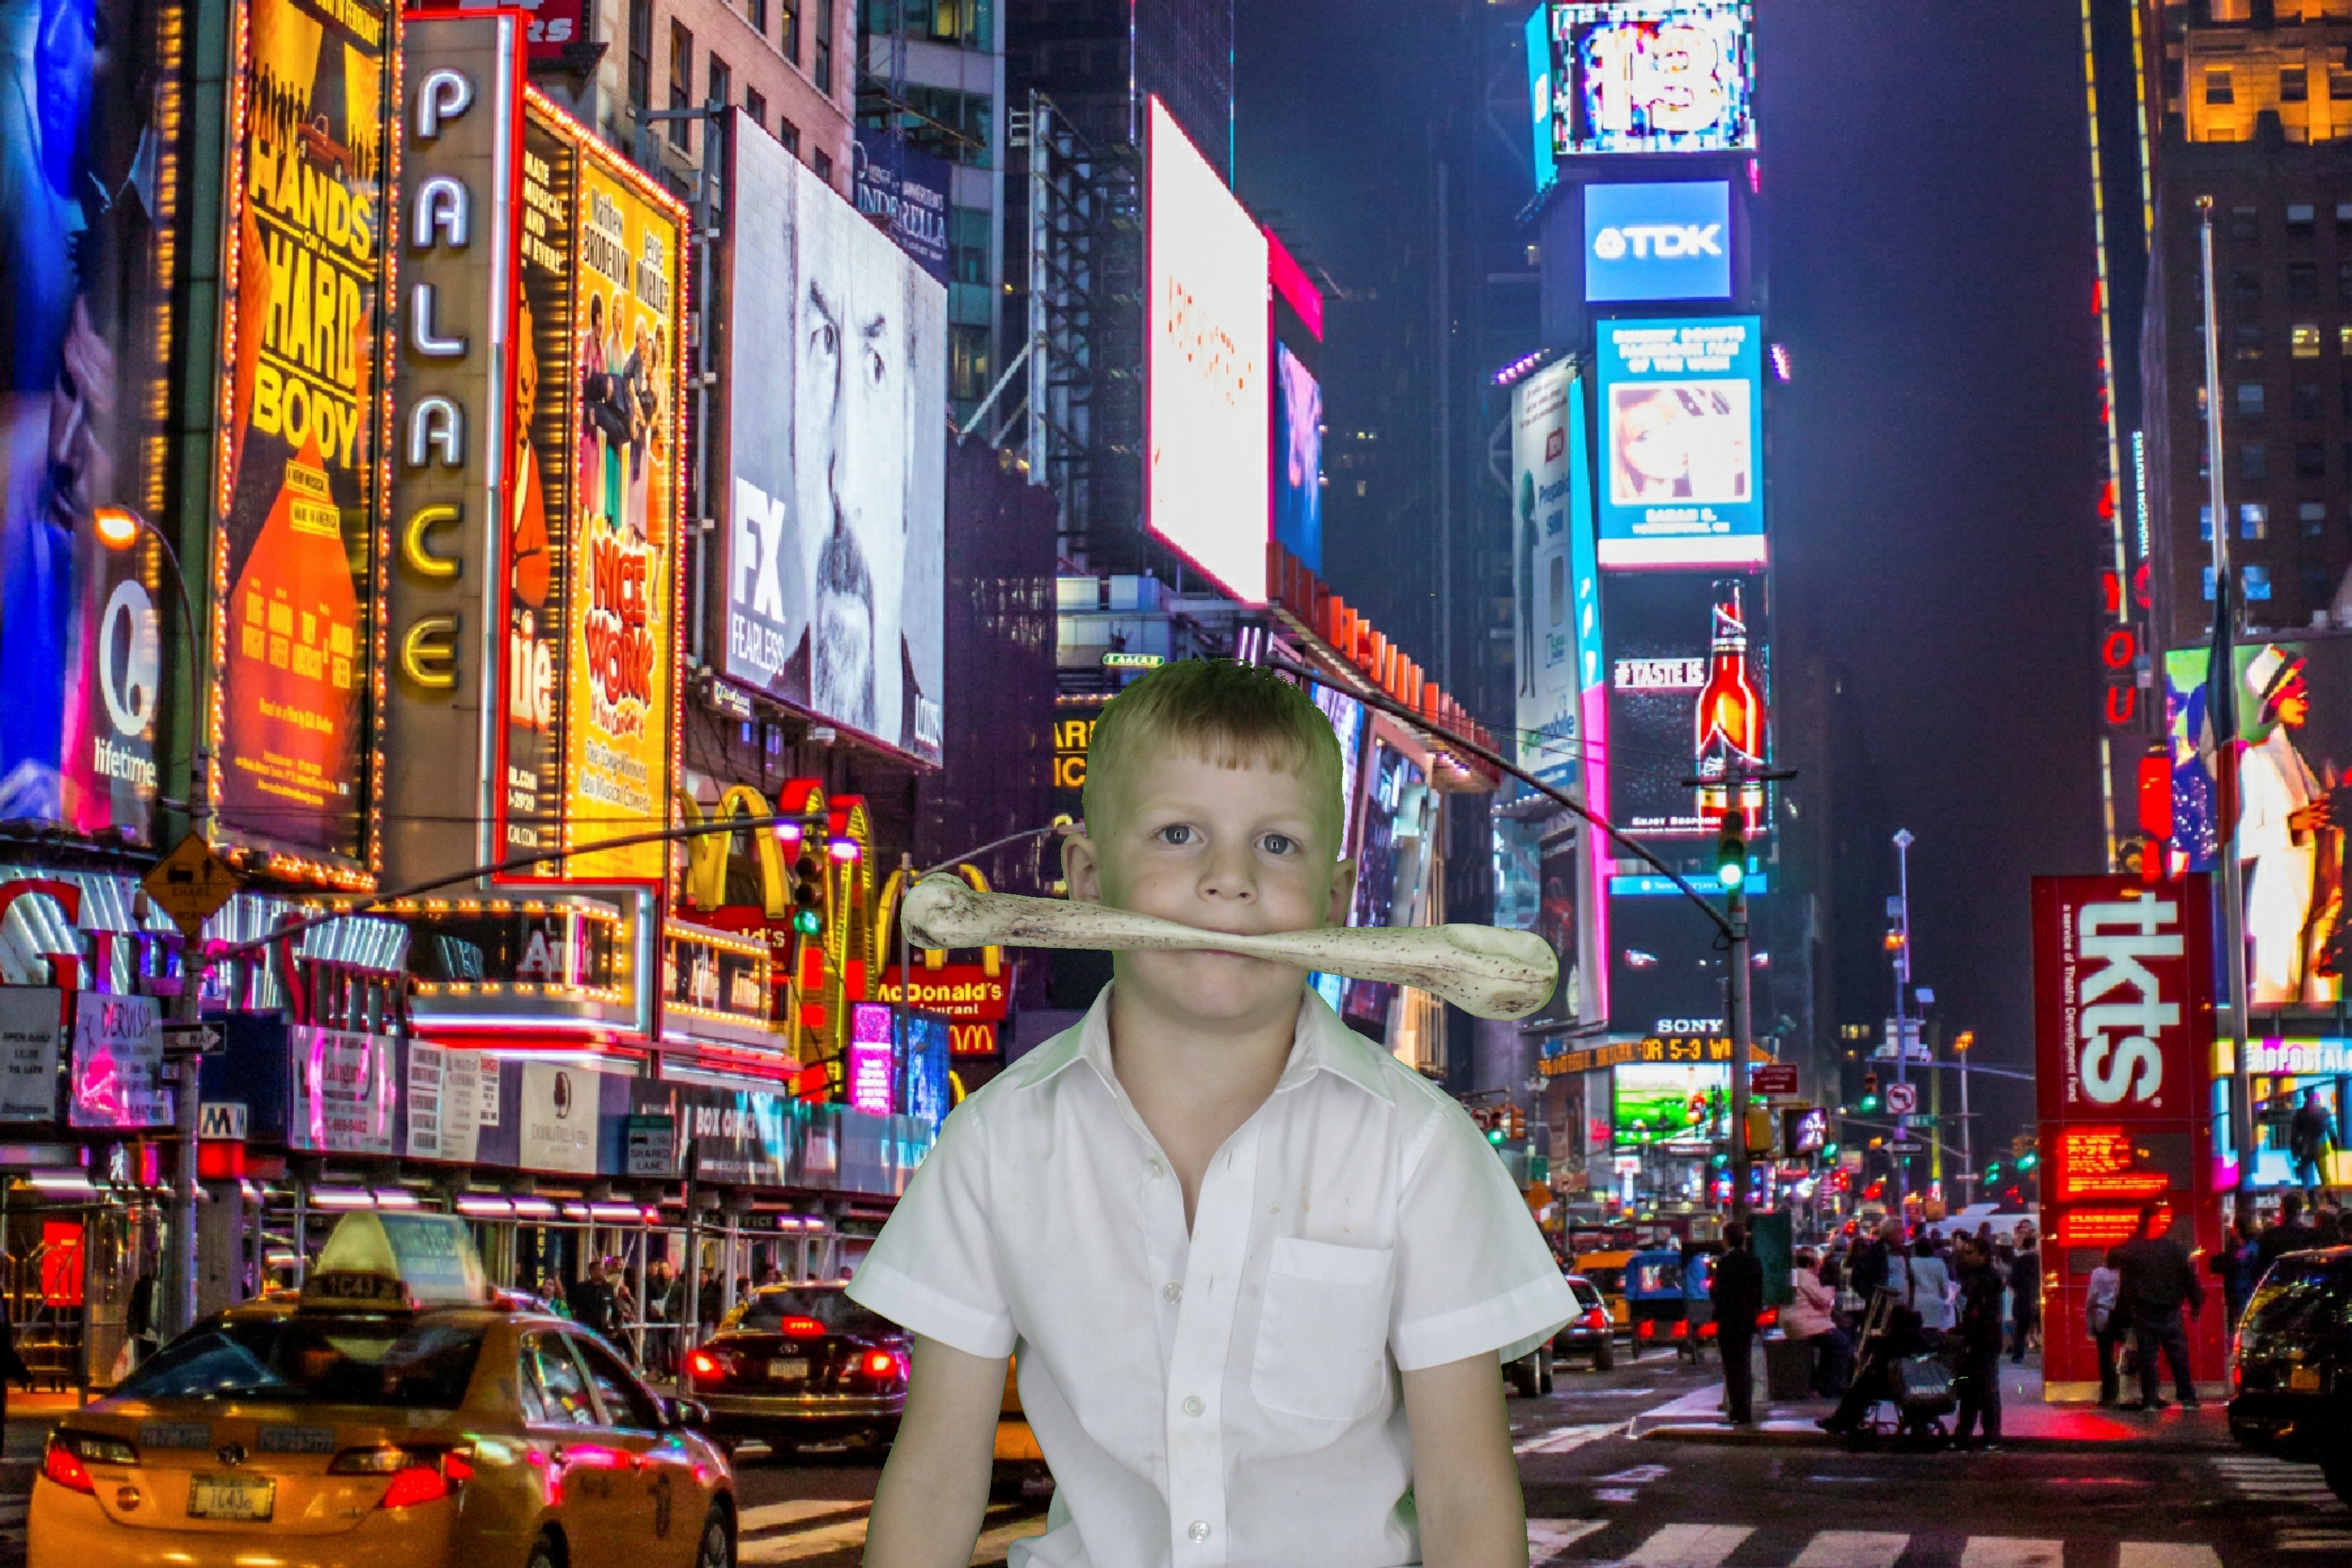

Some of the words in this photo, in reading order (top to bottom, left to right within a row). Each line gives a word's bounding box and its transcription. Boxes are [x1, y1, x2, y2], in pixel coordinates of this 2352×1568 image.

[248, 136, 373, 261] HANDS
[525, 206, 545, 238] AND
[1623, 223, 1722, 257] TDK
[264, 231, 361, 390] HARD
[401, 69, 474, 689] PALACE
[252, 365, 358, 468] BODY
[734, 475, 786, 624] FX
[590, 536, 647, 625] NICE
[732, 611, 785, 676] FEARLESS
[1108, 654, 1159, 666] LAMAR
[585, 614, 655, 708] WORK
[1614, 661, 1682, 685] #TASTE
[1684, 661, 1704, 684] IS
[1054, 720, 1096, 748] AR
[94, 736, 157, 787] lifetime
[172, 887, 212, 898] SHARE
[2079, 892, 2183, 1104] tkts
[1658, 1019, 1724, 1033] SONY
[2064, 1007, 2078, 1074] Development
[1669, 1039, 1701, 1060] 5-3
[2068, 1076, 2079, 1102] Fund
[696, 1107, 721, 1137] BOX
[630, 1147, 670, 1158] SHARED
[636, 1160, 665, 1171] LANE
